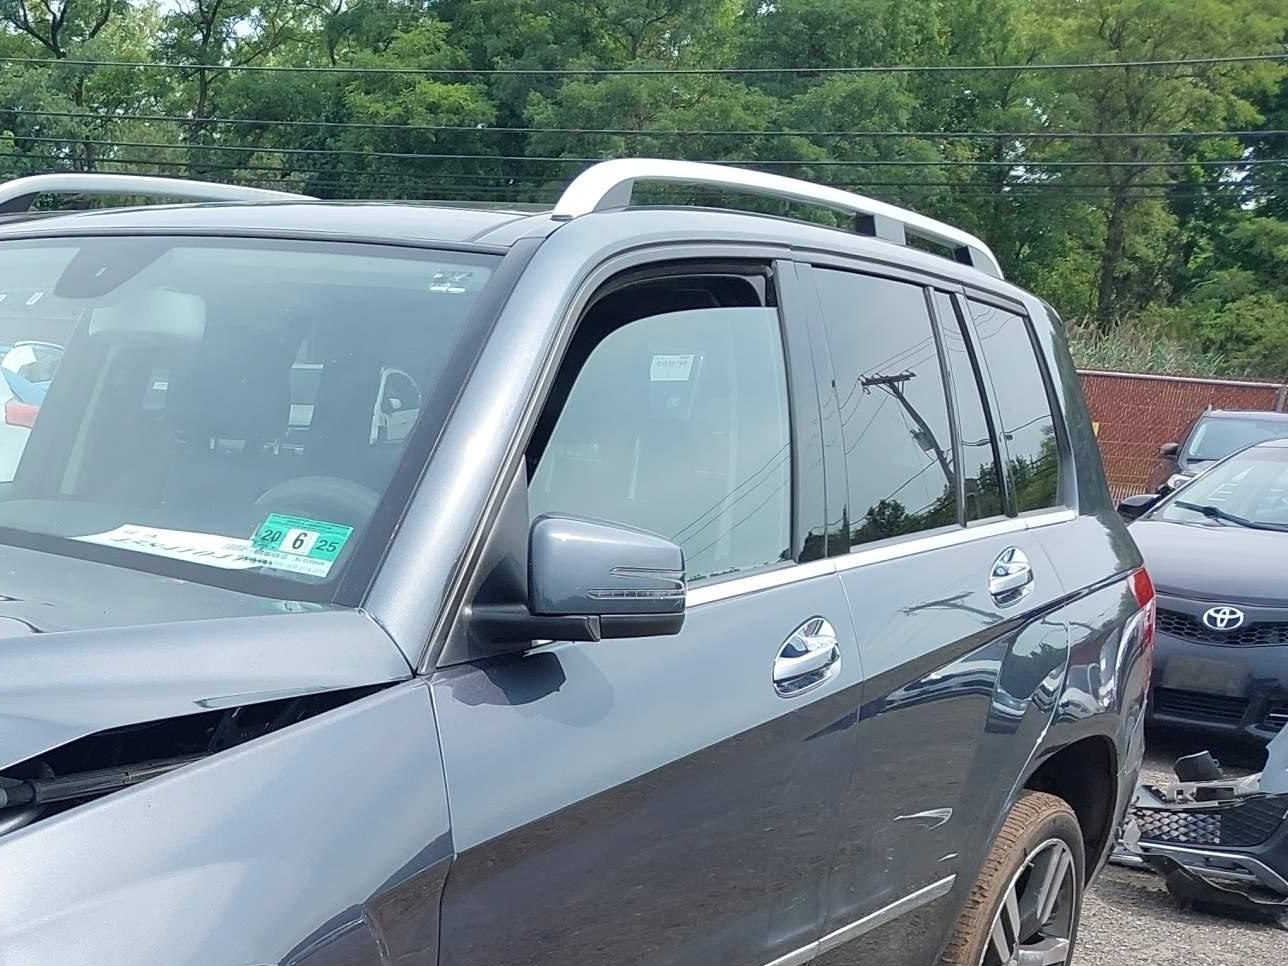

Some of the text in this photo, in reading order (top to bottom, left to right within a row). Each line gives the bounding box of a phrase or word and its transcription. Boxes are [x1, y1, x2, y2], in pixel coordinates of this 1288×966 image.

[260, 528, 340, 553] 20 6 25
